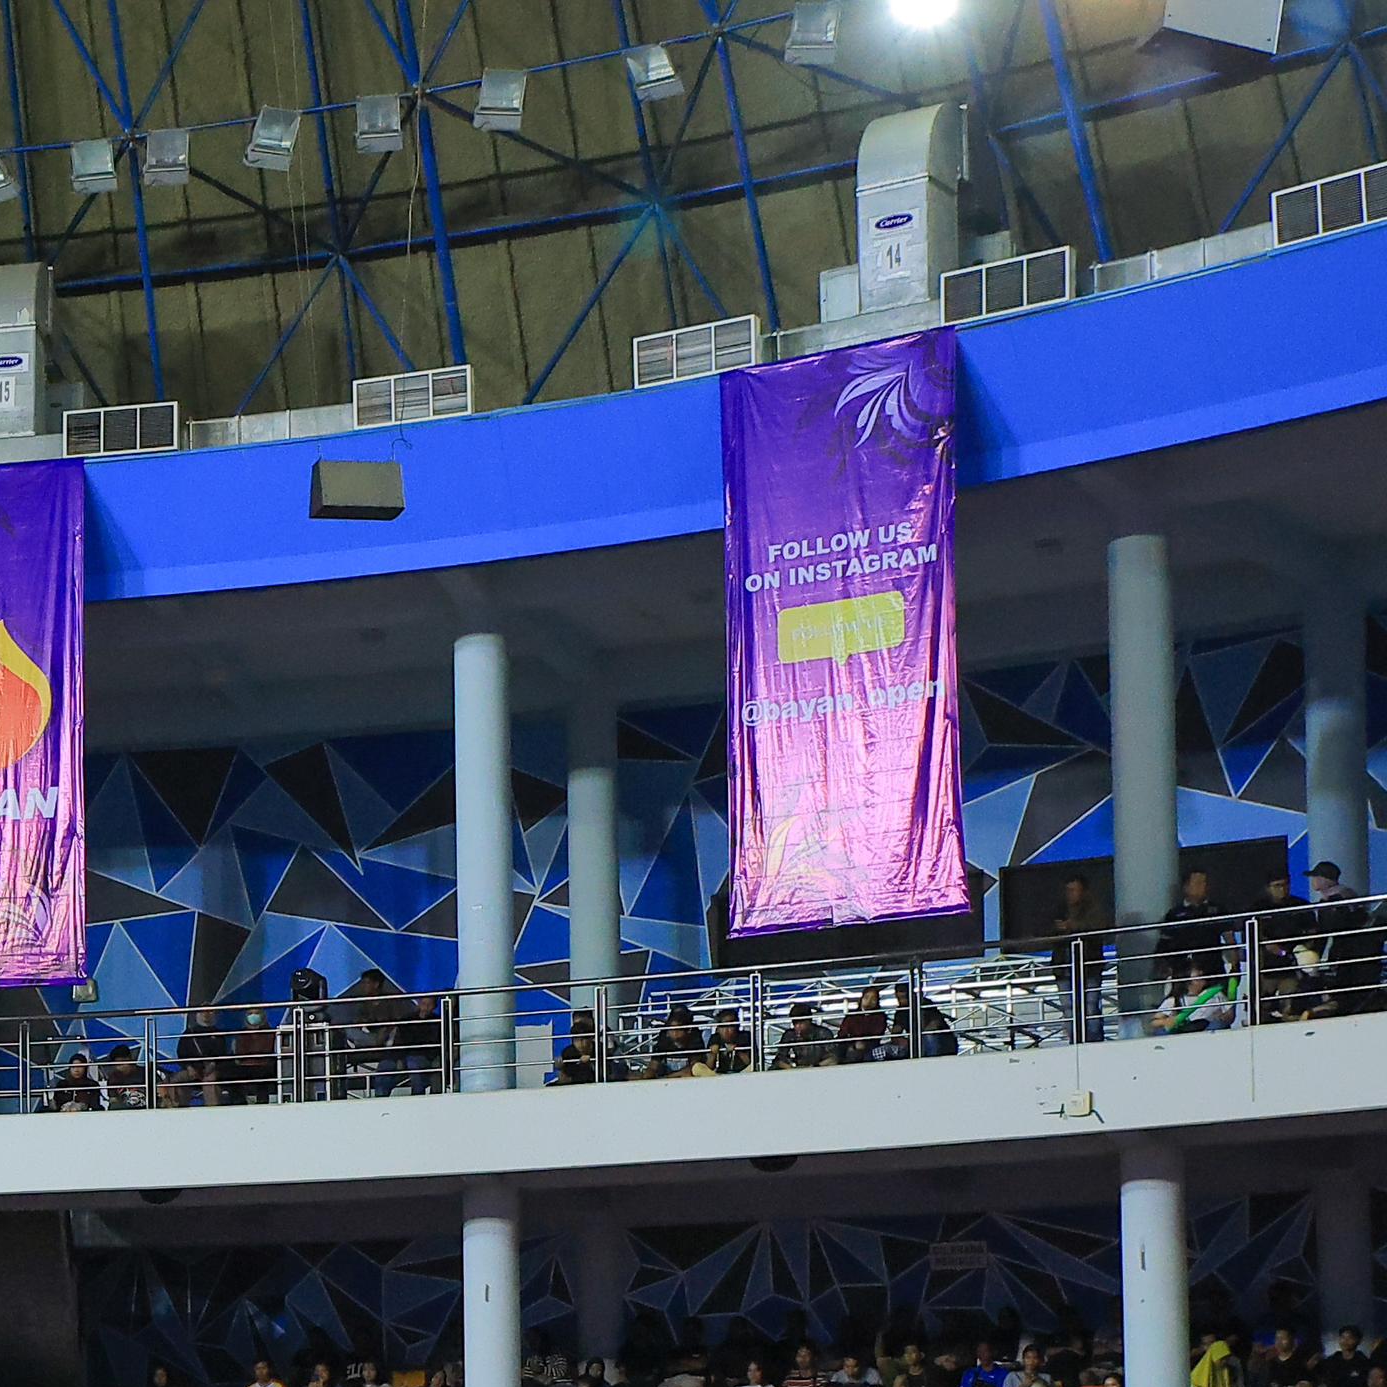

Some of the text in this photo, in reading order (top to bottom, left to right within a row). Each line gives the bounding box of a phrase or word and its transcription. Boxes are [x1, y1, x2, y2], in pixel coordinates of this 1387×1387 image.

[886, 243, 902, 269] 14
[768, 522, 914, 563] FOLLOW US
[745, 544, 938, 593] ON INSTAGRAM
